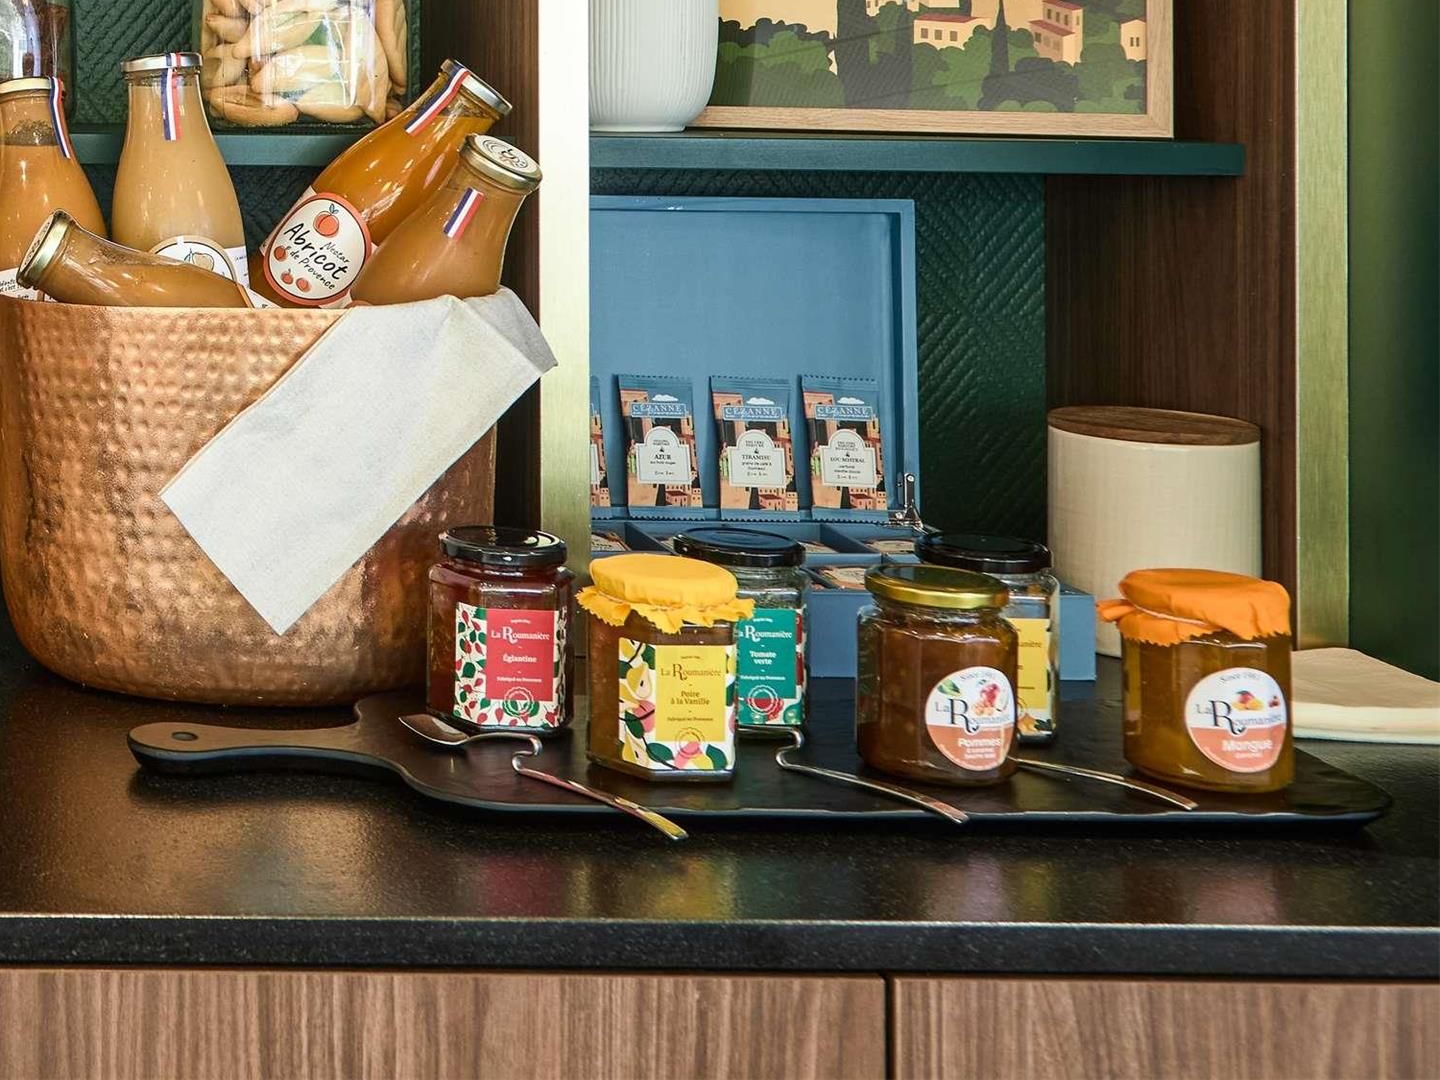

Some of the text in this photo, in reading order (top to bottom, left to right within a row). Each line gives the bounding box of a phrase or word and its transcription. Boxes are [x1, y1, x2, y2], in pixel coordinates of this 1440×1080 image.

[283, 222, 349, 280] Abricot
[323, 241, 350, 264] Nectar
[290, 250, 336, 290] de Provence
[490, 625, 550, 644] La Roumanière
[744, 624, 793, 642] Roumanière
[502, 652, 538, 664] Églantine
[749, 650, 777, 659] Tomate
[672, 663, 722, 681] Roumanière
[681, 690, 700, 698] Poire
[684, 697, 710, 705] Vanille
[1221, 739, 1273, 753] Mangue
